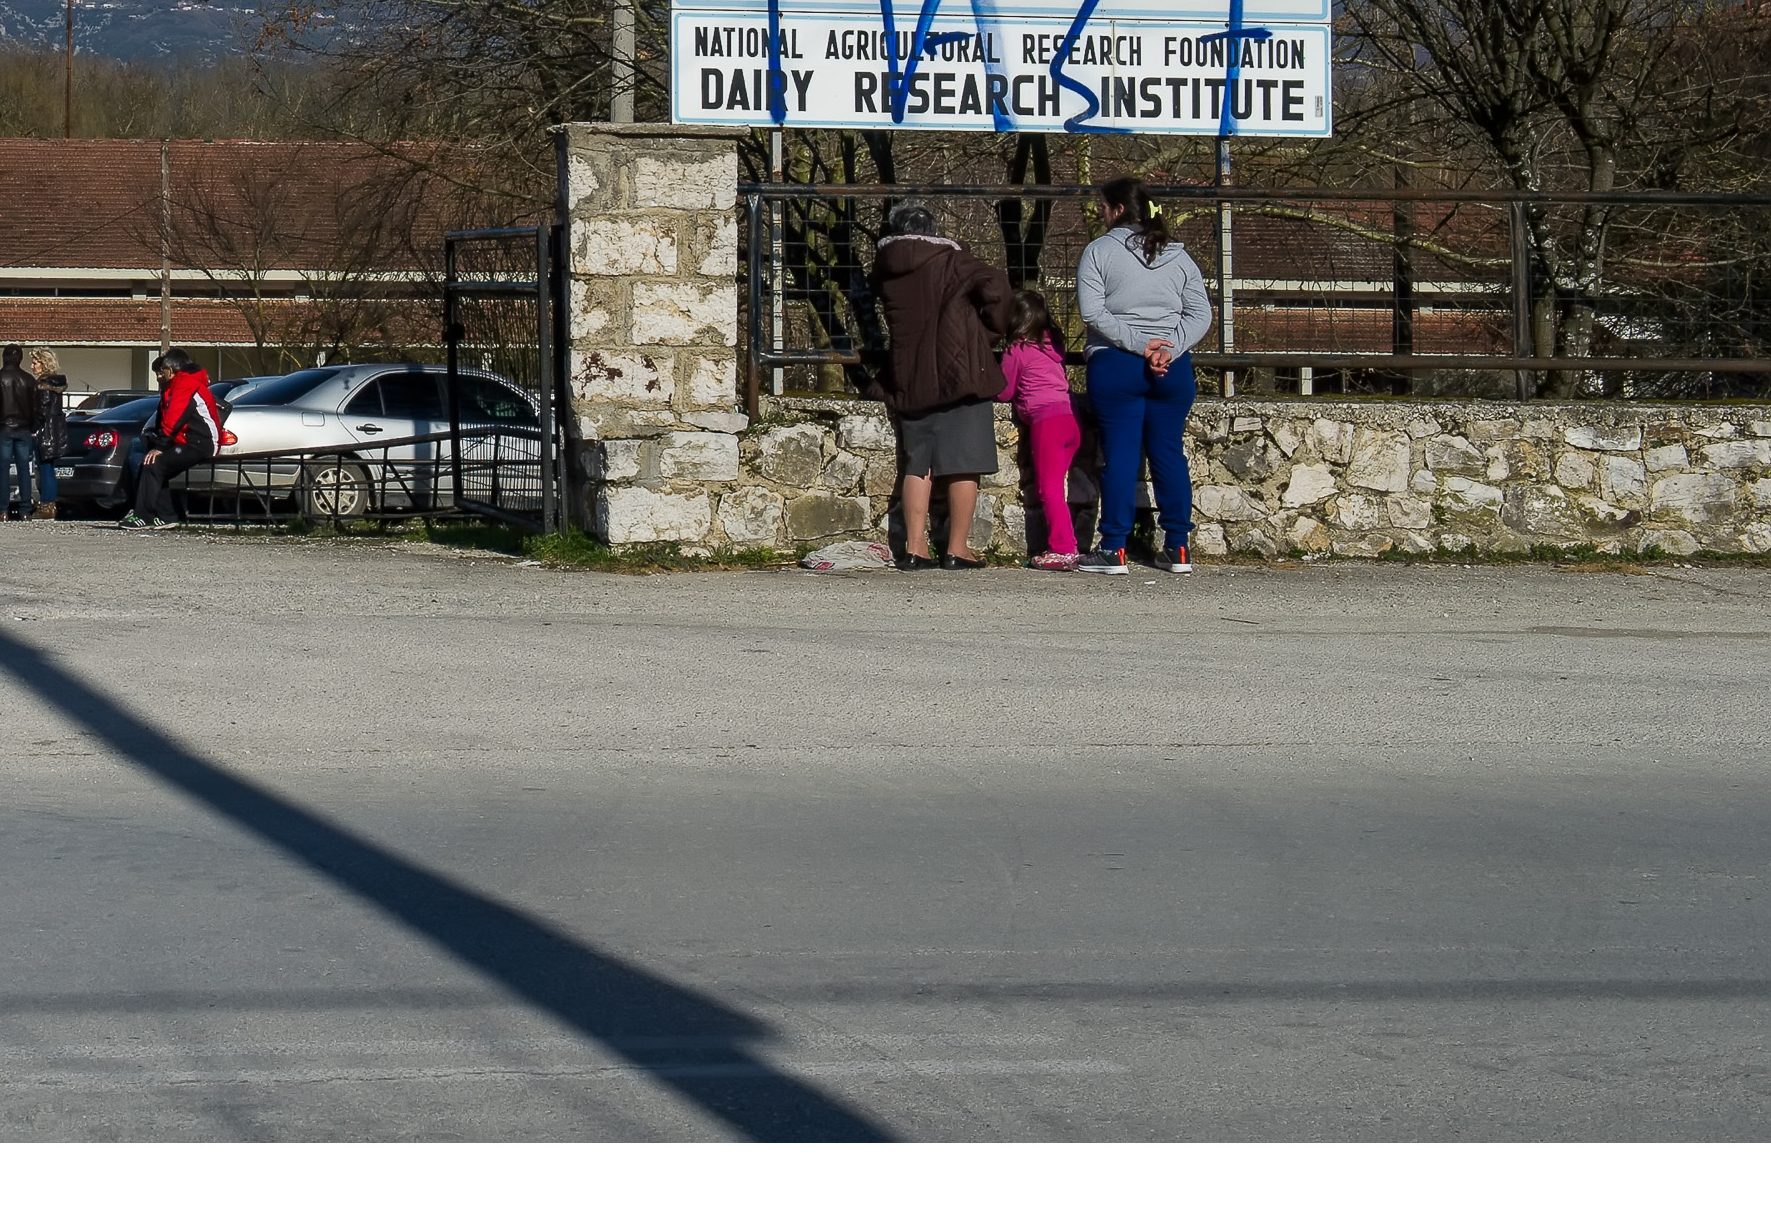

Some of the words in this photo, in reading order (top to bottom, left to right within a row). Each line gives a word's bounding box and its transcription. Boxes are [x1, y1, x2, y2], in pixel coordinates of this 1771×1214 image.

[694, 26, 804, 59] NATIONAL
[825, 29, 1001, 64] AGRICULTURAL
[1164, 36, 1305, 69] FOUNDATION
[701, 67, 814, 112] DAIRY
[854, 71, 1060, 117] RESEARCH
[1101, 76, 1305, 121] INSTITUTE
